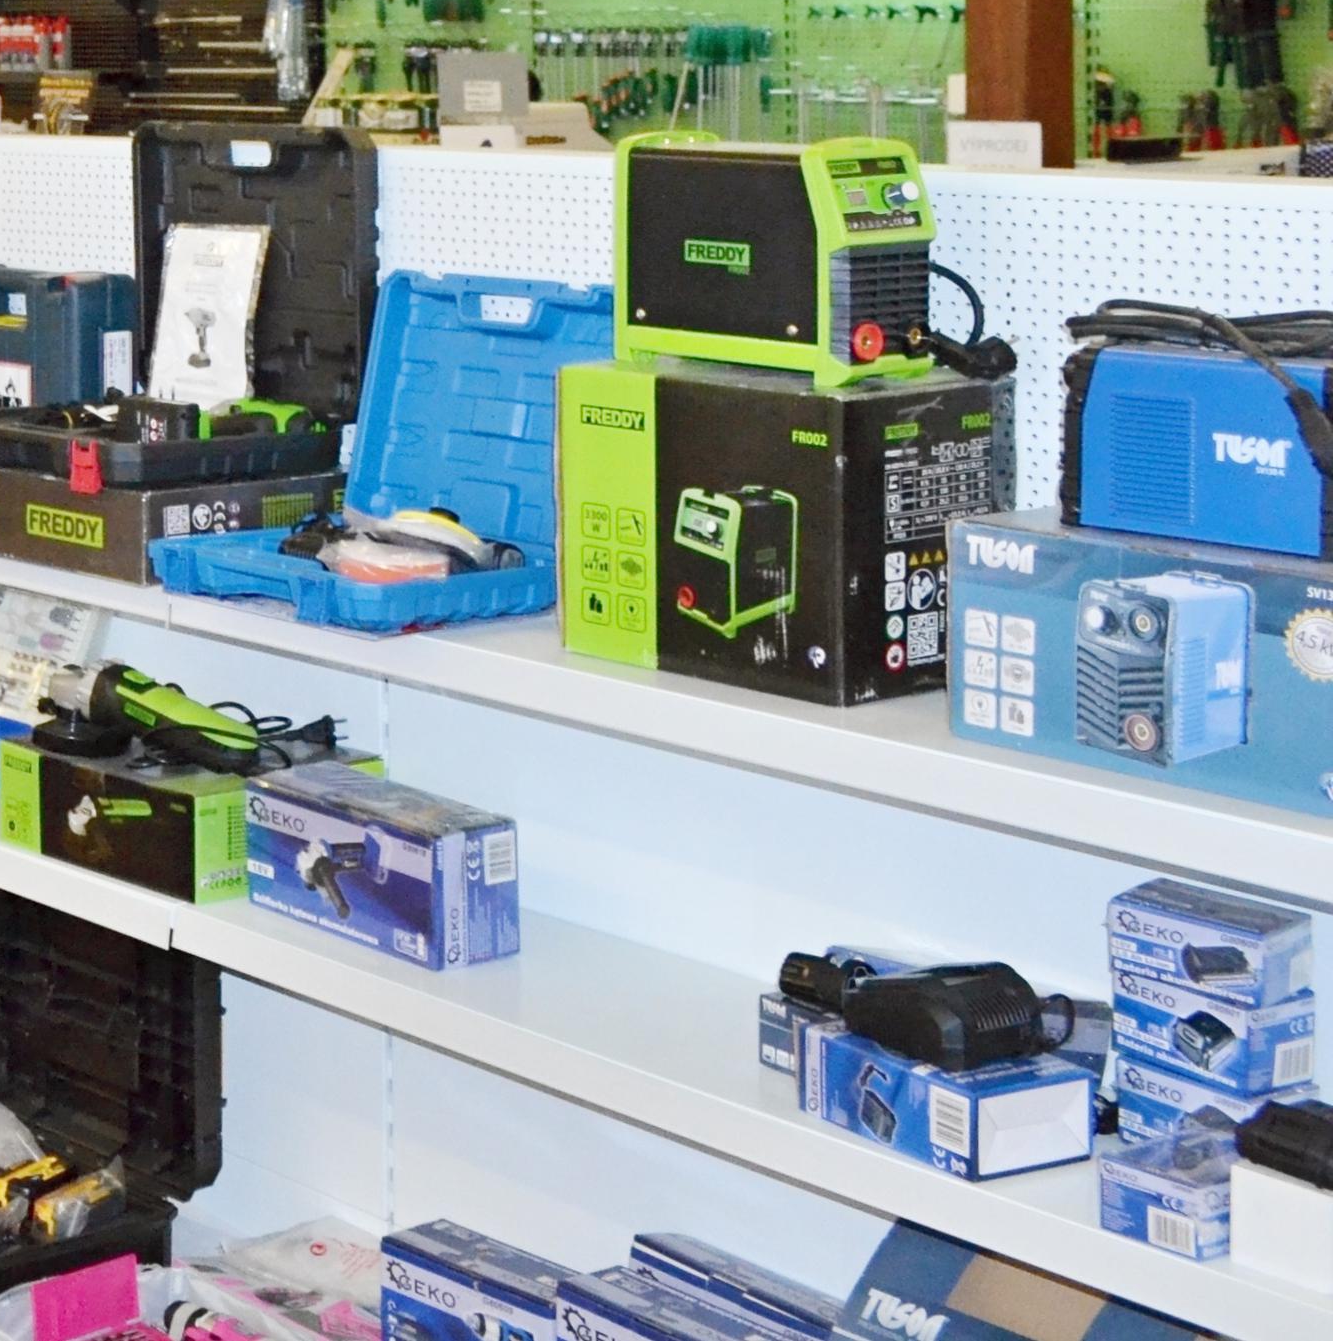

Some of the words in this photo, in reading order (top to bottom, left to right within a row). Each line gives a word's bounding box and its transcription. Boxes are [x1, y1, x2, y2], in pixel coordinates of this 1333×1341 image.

[686, 242, 747, 263] FREDDY
[583, 406, 644, 430] FREDDY
[791, 431, 828, 447] FR002
[1212, 432, 1293, 468] TUSON
[29, 509, 100, 544] FREDDY
[966, 534, 1038, 574] TUSON
[252, 800, 306, 833] GEKO
[447, 908, 461, 964] GEKO
[1119, 912, 1183, 944] GEKO
[1119, 974, 1177, 1008] GEKO
[807, 1067, 819, 1112] GEKO
[1126, 1069, 1183, 1104] GEKO
[388, 1262, 457, 1310] GEKO
